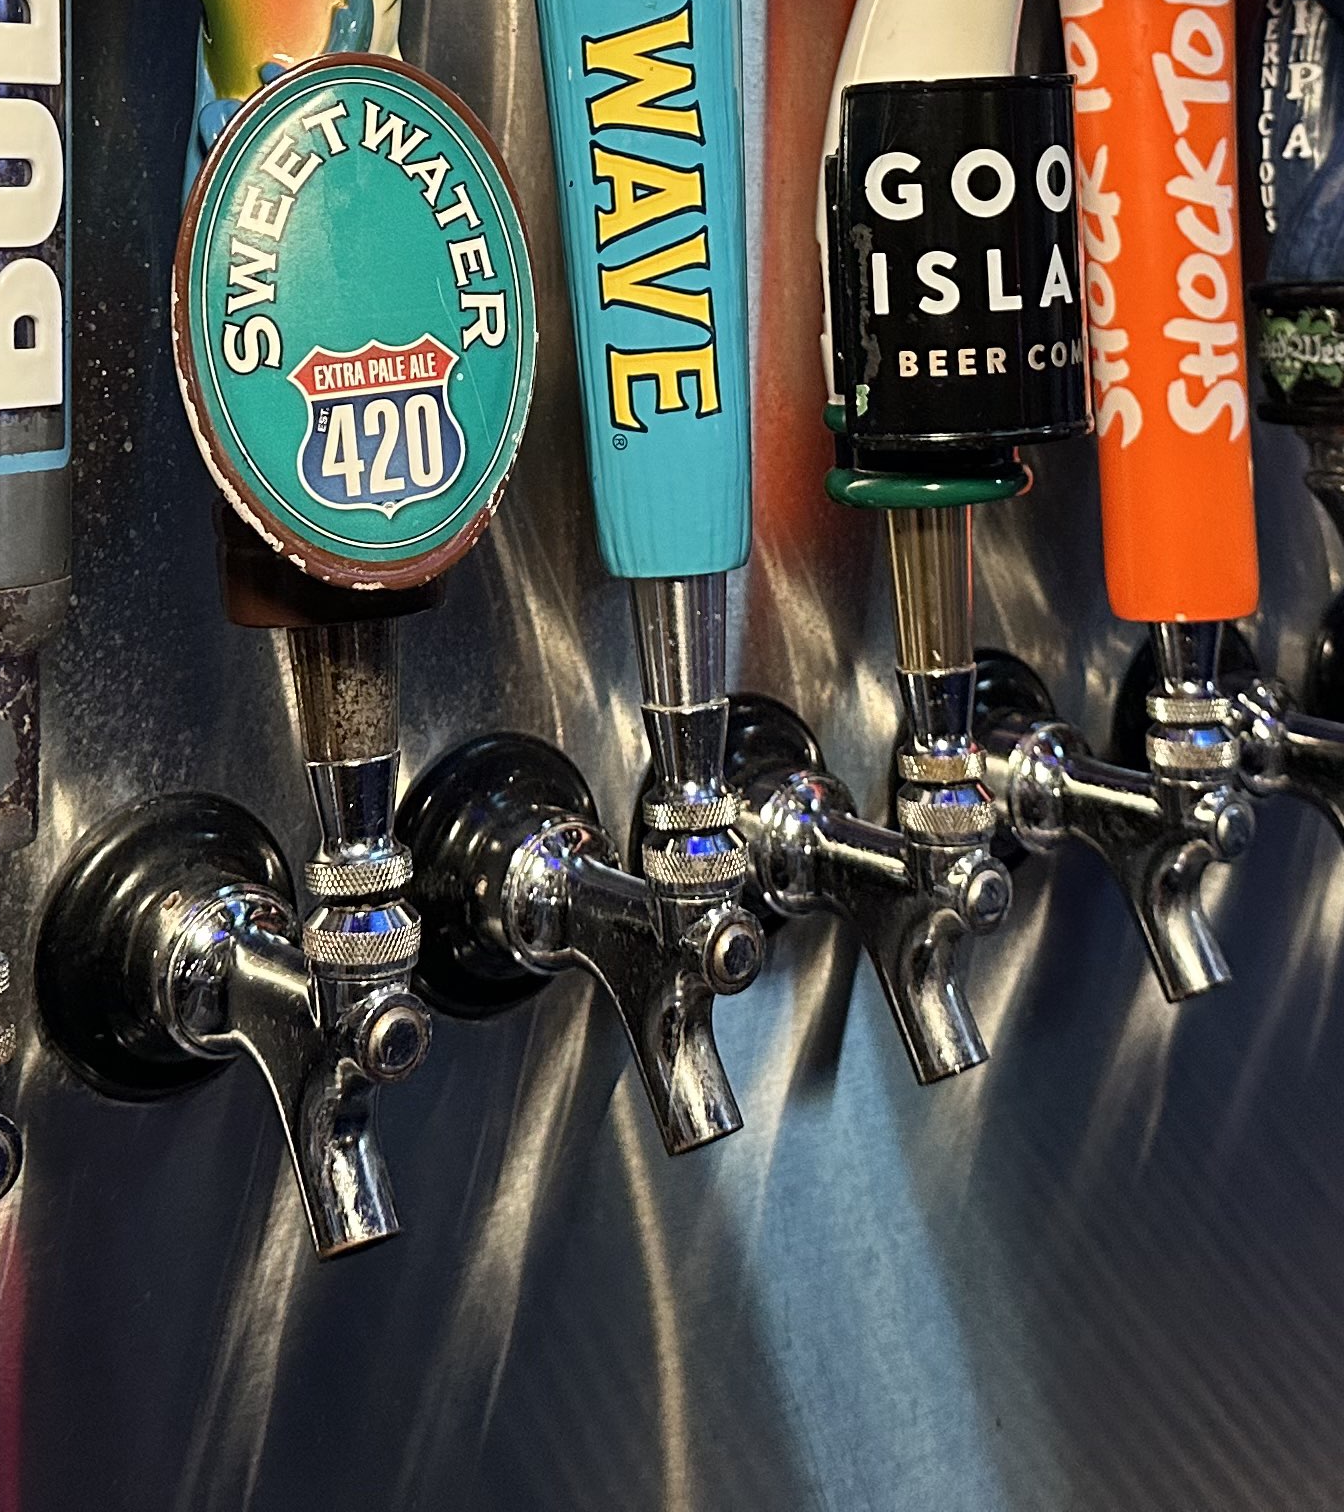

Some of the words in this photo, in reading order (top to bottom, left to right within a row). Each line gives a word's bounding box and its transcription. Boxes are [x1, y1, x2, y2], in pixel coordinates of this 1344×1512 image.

[864, 143, 1073, 221] GOO
[872, 243, 1074, 316] ISLA
[1166, 137, 1247, 442] SHOCK
[314, 361, 365, 390] EXTRA
[368, 356, 406, 383] PALE
[410, 352, 437, 379] ALE
[898, 346, 1007, 378] BEER
[322, 394, 443, 497] 420
